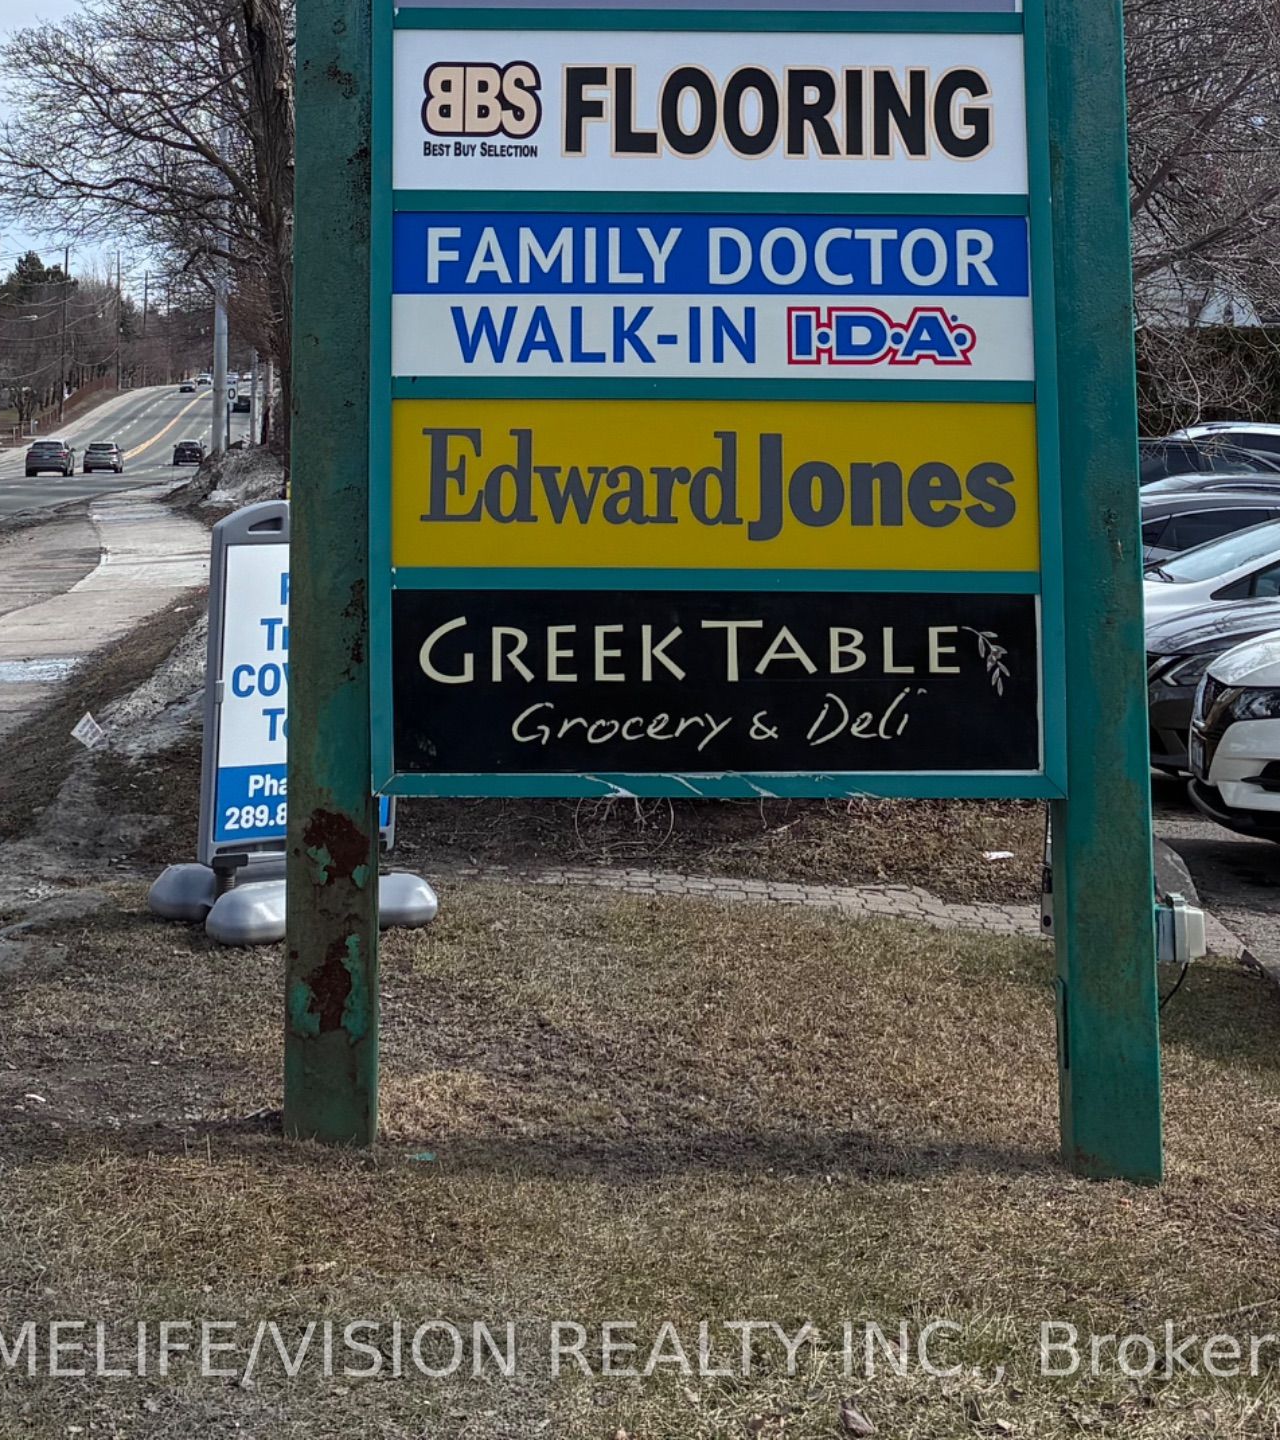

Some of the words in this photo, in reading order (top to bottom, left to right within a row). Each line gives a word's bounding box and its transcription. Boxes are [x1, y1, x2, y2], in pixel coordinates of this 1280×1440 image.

[421, 60, 542, 140] BBS
[560, 64, 994, 161] FLOORING
[423, 140, 452, 157] BEST
[453, 141, 477, 157] BUY
[479, 141, 538, 158] SELECTION
[426, 226, 683, 284] FAMILY
[707, 227, 999, 287] DOCTOR
[449, 305, 756, 364] WALK-IN
[419, 427, 743, 527] Edward
[747, 432, 1017, 543] Jones
[419, 615, 686, 684] GREEK
[701, 619, 962, 681] TABLE
[510, 701, 733, 752] Grocery
[748, 715, 779, 741] &
[806, 686, 928, 747] Deli
